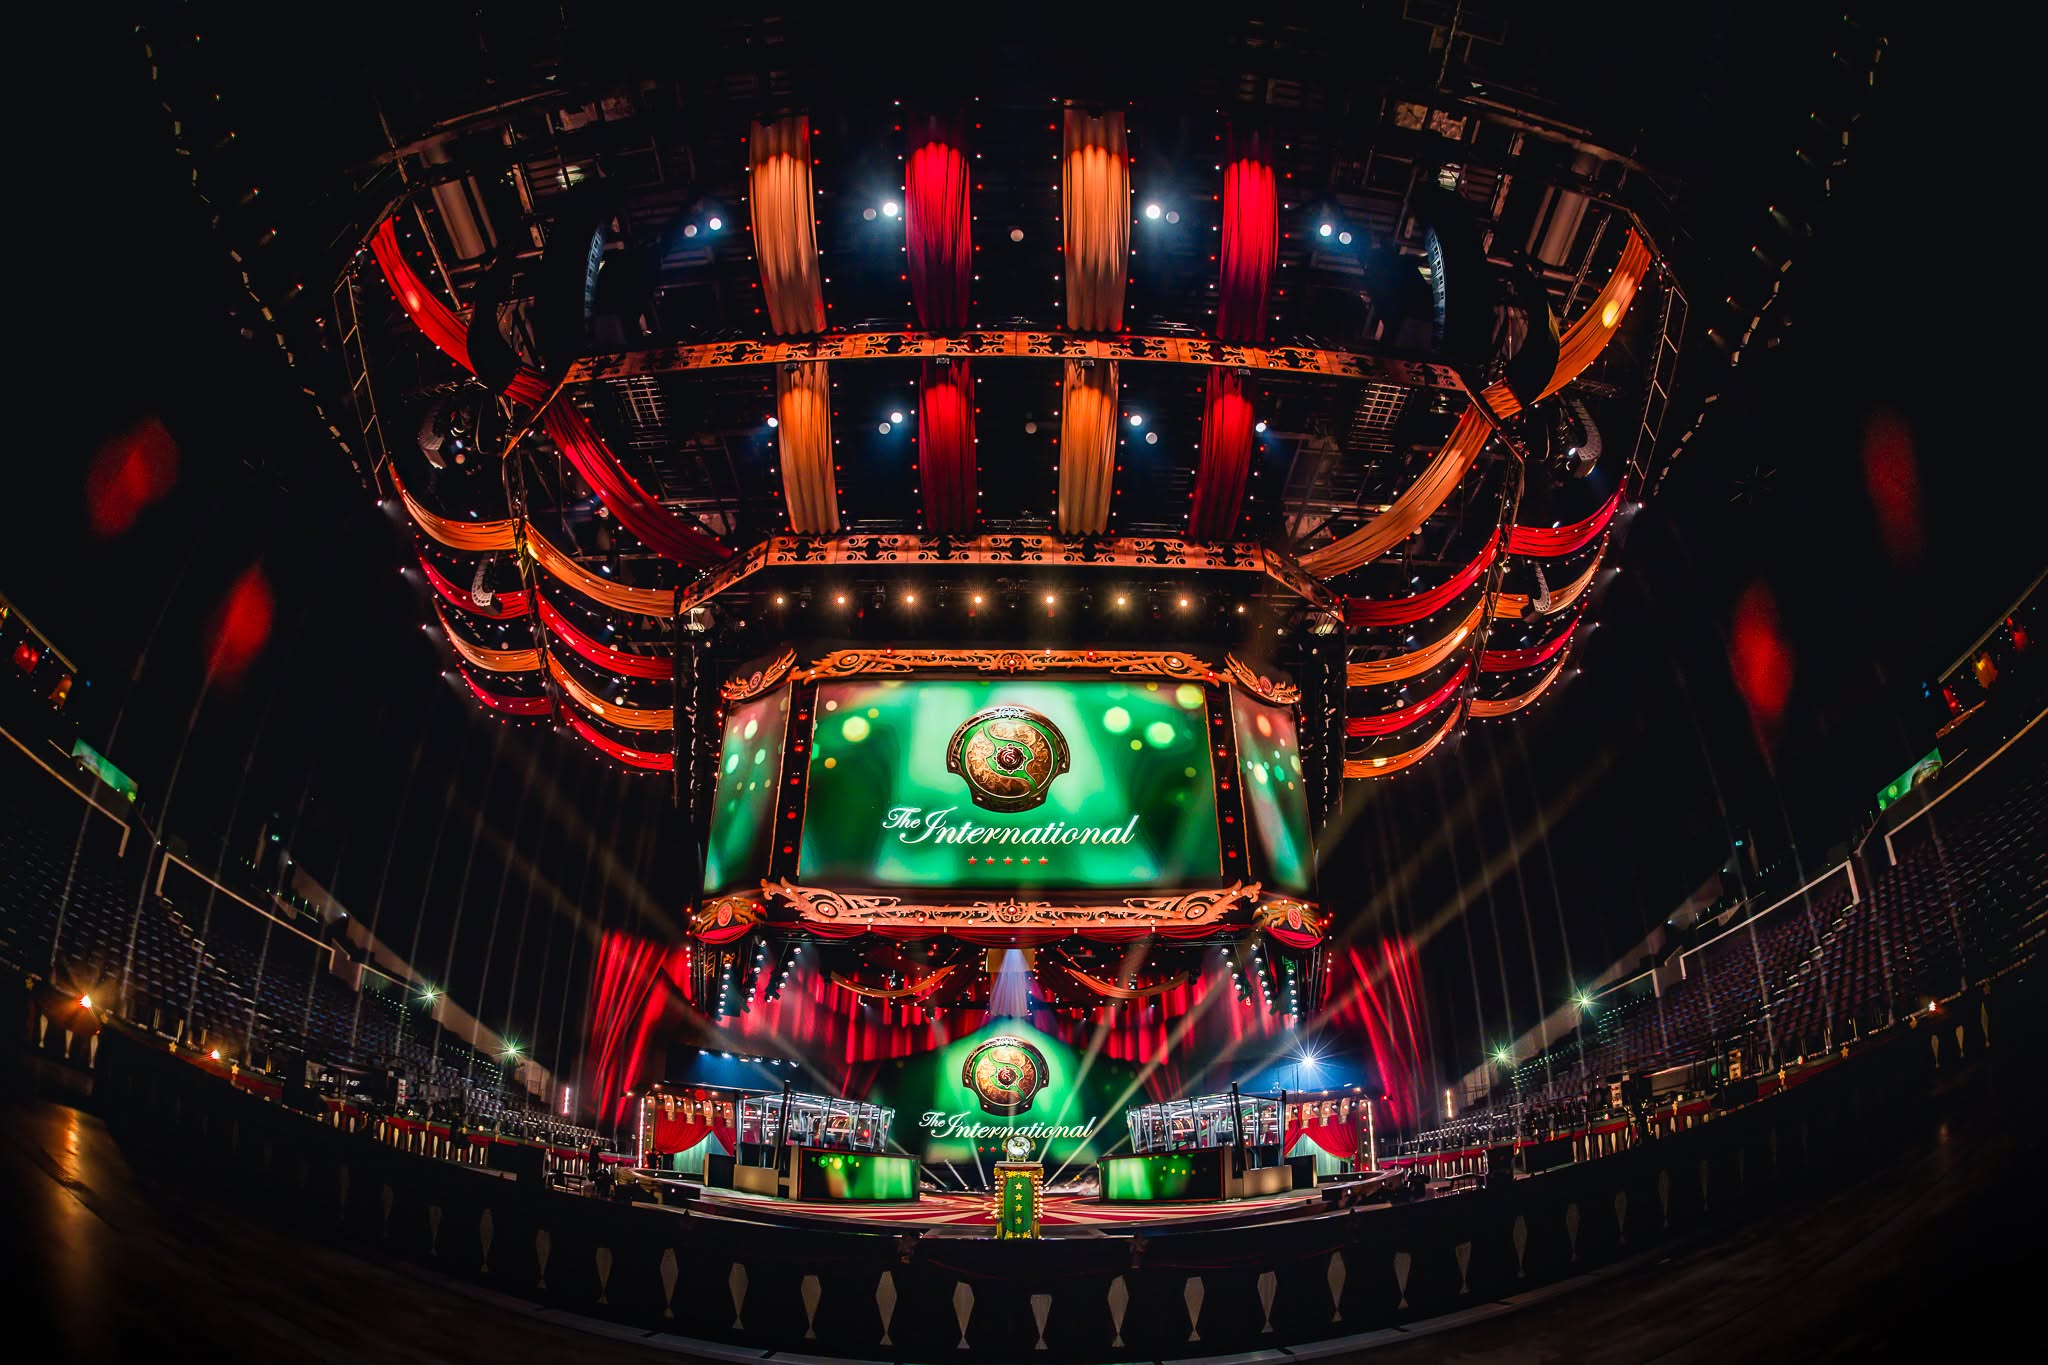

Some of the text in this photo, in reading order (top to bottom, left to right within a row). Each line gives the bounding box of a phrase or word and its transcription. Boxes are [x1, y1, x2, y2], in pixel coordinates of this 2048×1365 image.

[882, 805, 1140, 846] The International
[918, 1111, 1097, 1139] The International
